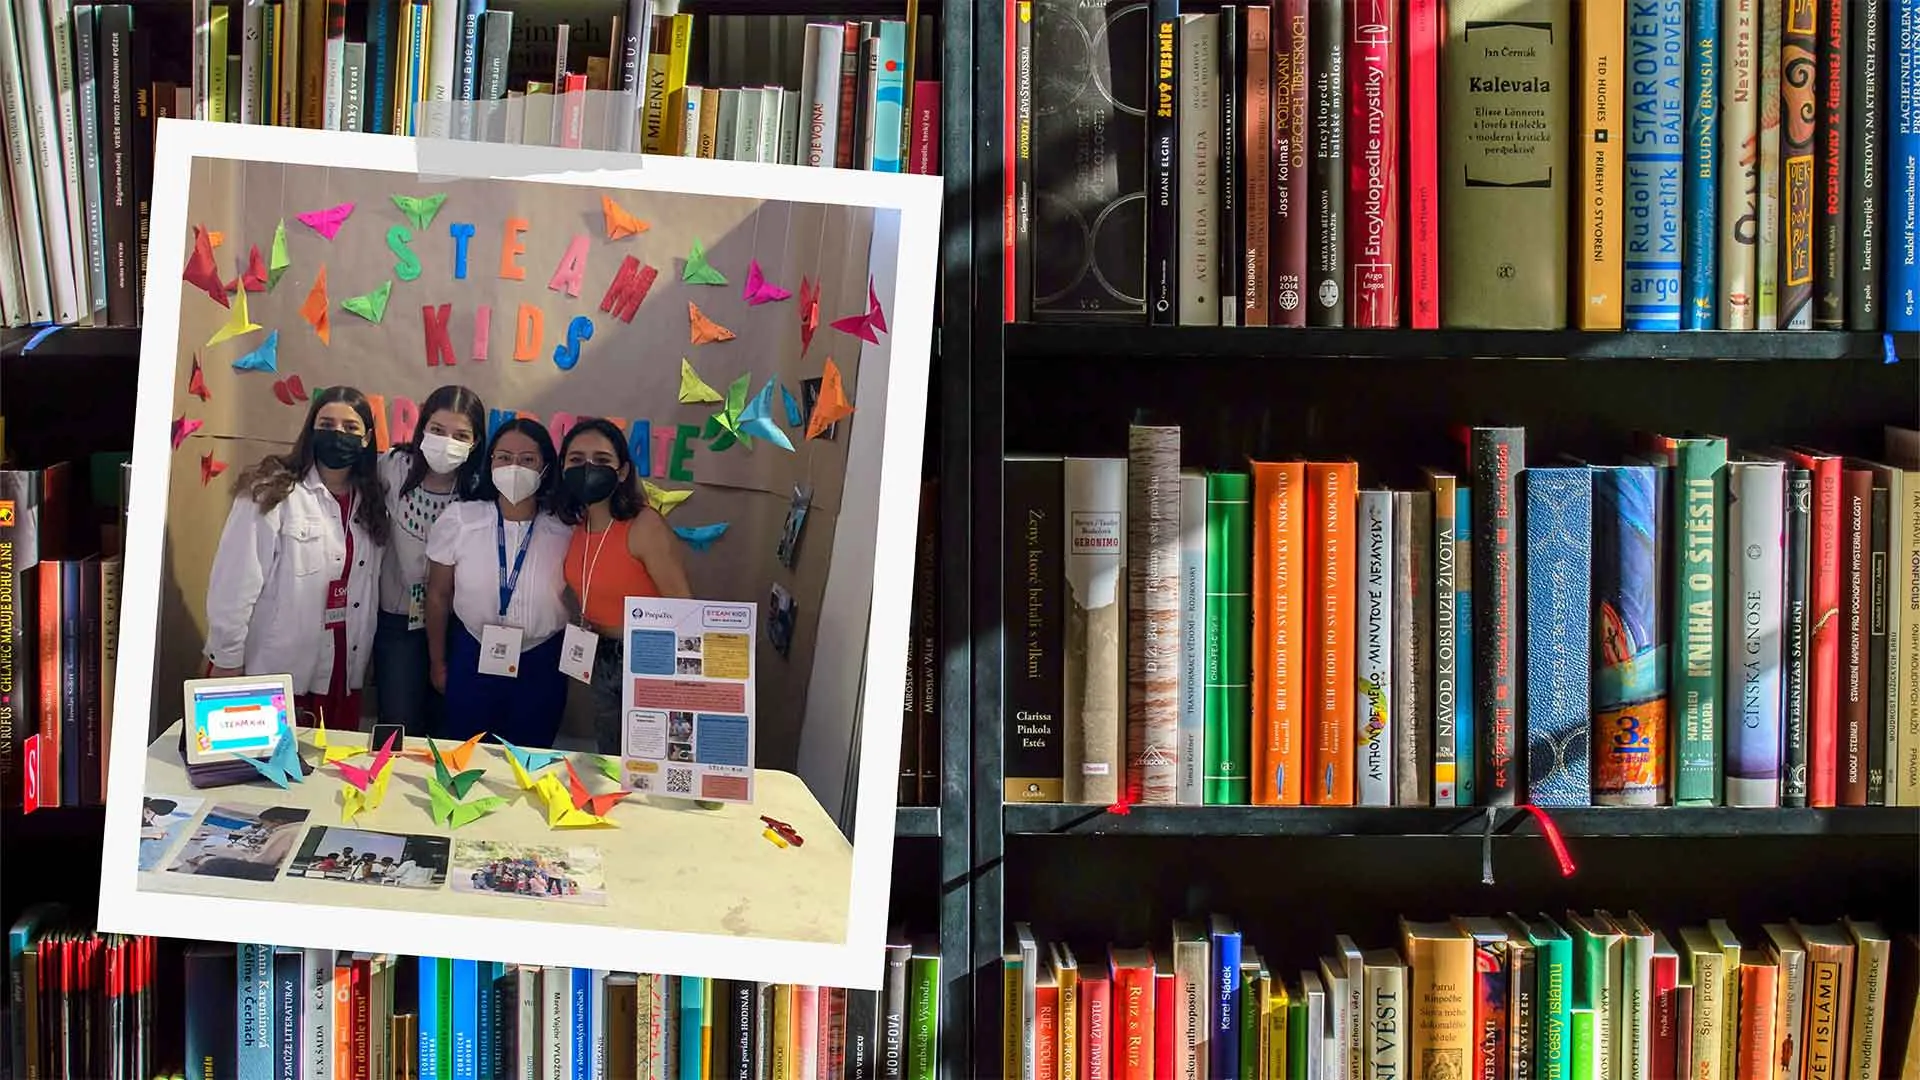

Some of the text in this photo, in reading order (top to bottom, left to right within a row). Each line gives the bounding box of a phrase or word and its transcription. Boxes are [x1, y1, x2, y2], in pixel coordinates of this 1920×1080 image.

[1485, 47, 1499, 59] Jan
[1900, 8, 1911, 49] KOLEM
[1331, 45, 1341, 108] mytologie
[1470, 77, 1551, 94] Kalevala
[1665, 77, 1680, 89] A
[1734, 18, 1749, 102] Nevěsta z
[648, 69, 664, 138] MILENKY
[1317, 72, 1329, 158] Encyklopedie
[1365, 66, 1384, 134] mystiky
[1598, 56, 1608, 122] TED HUGHES
[812, 103, 824, 139] VOJNA!
[1663, 100, 1681, 144] BÁJE
[1865, 111, 1874, 128] NA
[1160, 137, 1170, 206] DUANE ELGIN
[1278, 139, 1289, 217] Josef Kolmaš
[1292, 156, 1304, 167] O
[1863, 132, 1874, 188] OSTROVY,
[1365, 139, 1384, 256] Encyklopedie
[1630, 165, 1649, 252] Rudolf
[1659, 168, 1677, 253] Mertlík
[386, 217, 658, 324] STEAM
[1862, 239, 1872, 270] Lucien
[1905, 232, 1916, 265] Rudolf
[1630, 276, 1679, 306] argo
[422, 303, 594, 370] KIDS
[1278, 472, 1289, 532] INKOGNITO
[1327, 472, 1338, 532] INKOGNITO
[1853, 496, 1862, 530] GOLGOTY
[1074, 537, 1119, 547] GERONIMO
[1685, 478, 1714, 677] KNIHA O ŠTĚSTÍ
[1277, 630, 1288, 645] PO
[1326, 630, 1337, 645] PO
[1436, 528, 1453, 737] NÁVOD K OBSLUZE ŽIVOTA
[1791, 600, 1802, 657] SATURNI
[1851, 615, 1860, 631] PRO
[1744, 590, 1762, 729] ČÍNSKÁ GNOSE
[1017, 711, 1051, 721] Clarissa
[1017, 725, 1051, 734] Pinkola
[1023, 737, 1046, 748] Estés
[1702, 701, 1714, 741] RICARD
[1849, 721, 1858, 783] RUDOLF STEINER
[315, 968, 324, 1010] K. ČAPEK
[1221, 965, 1232, 1029] Karel Sládek
[1702, 963, 1712, 1002] prorok
[1816, 969, 1832, 1042] ISLÁMU
[244, 996, 257, 1047] Čechách
[284, 980, 293, 1042] LITERATURA?
[918, 980, 930, 1071] arabského Východu
[1371, 987, 1396, 1054] VÉST
[1861, 958, 1878, 1069] buddhistické meditace
[315, 1025, 324, 1055] ŠALDA
[355, 1024, 366, 1063] double
[741, 1032, 749, 1062] povídka
[856, 1036, 864, 1067] VRECKU
